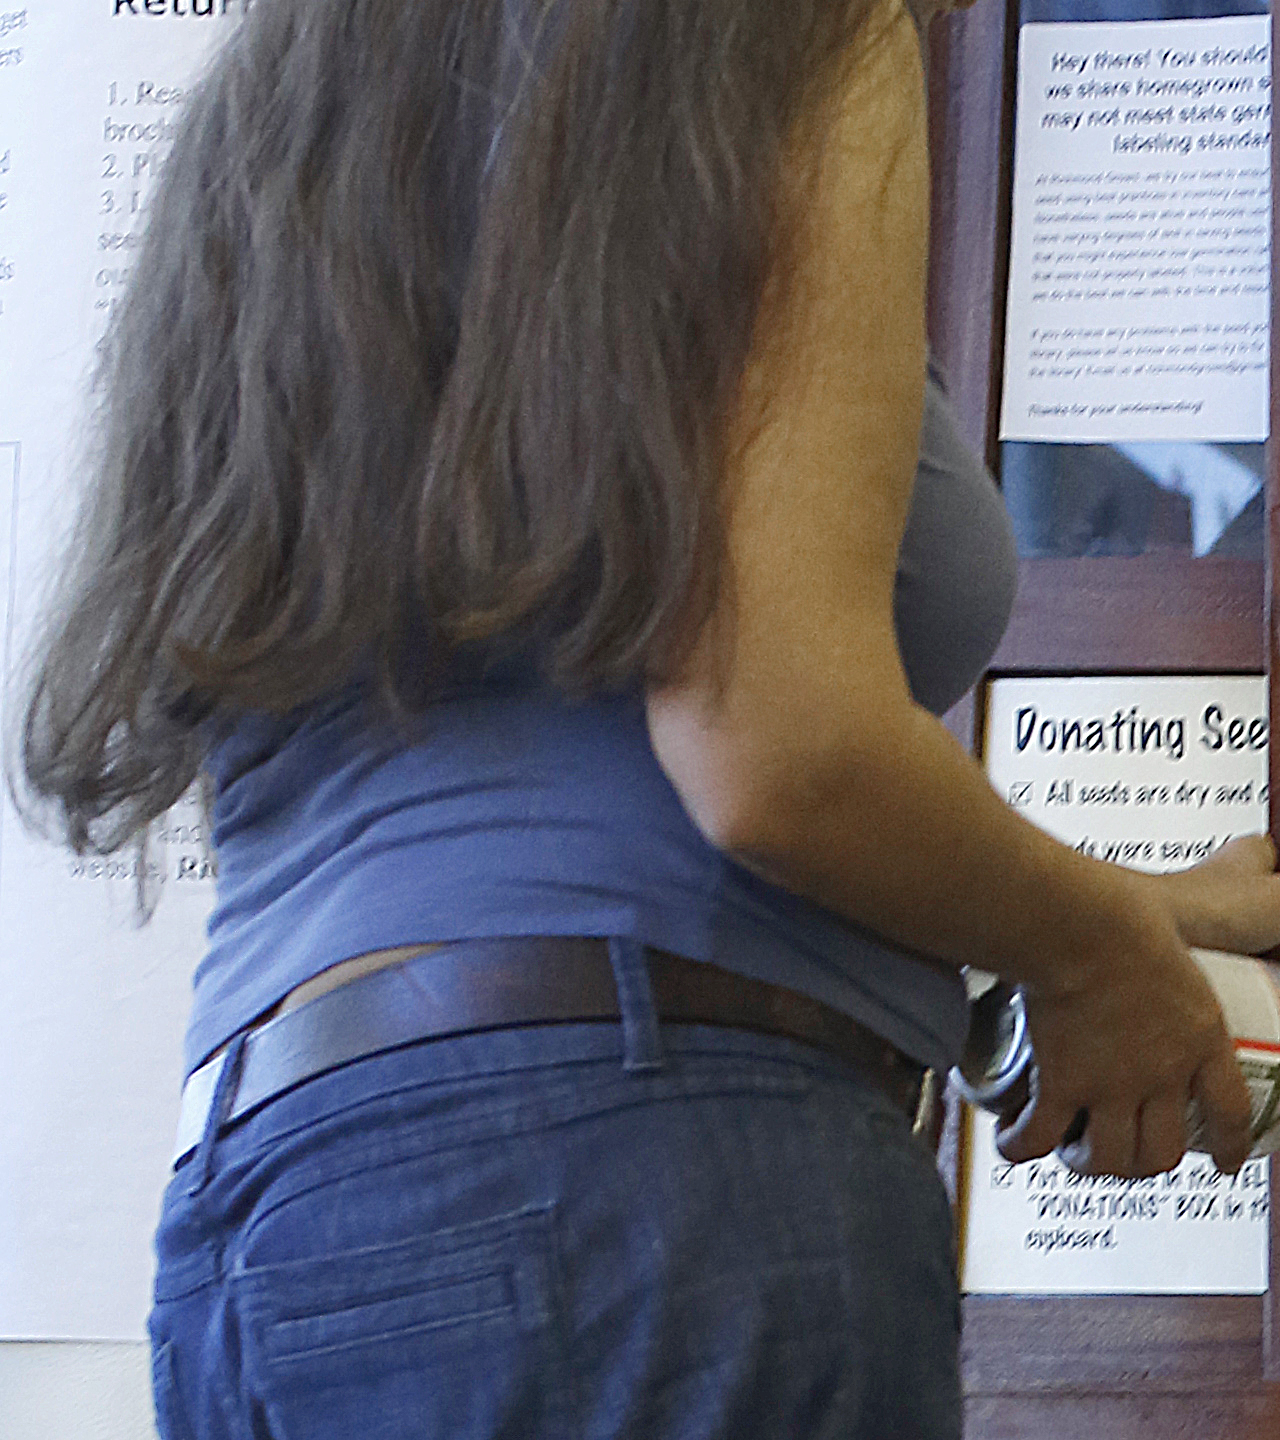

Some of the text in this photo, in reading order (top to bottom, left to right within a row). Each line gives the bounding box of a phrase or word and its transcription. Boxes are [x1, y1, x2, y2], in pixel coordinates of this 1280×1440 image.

[1014, 704, 1186, 761] Donating
[1045, 778, 1074, 806] All
[1134, 783, 1171, 806] are
[1174, 779, 1211, 808] dry
[1214, 779, 1254, 806] and
[1102, 839, 1154, 862] were
